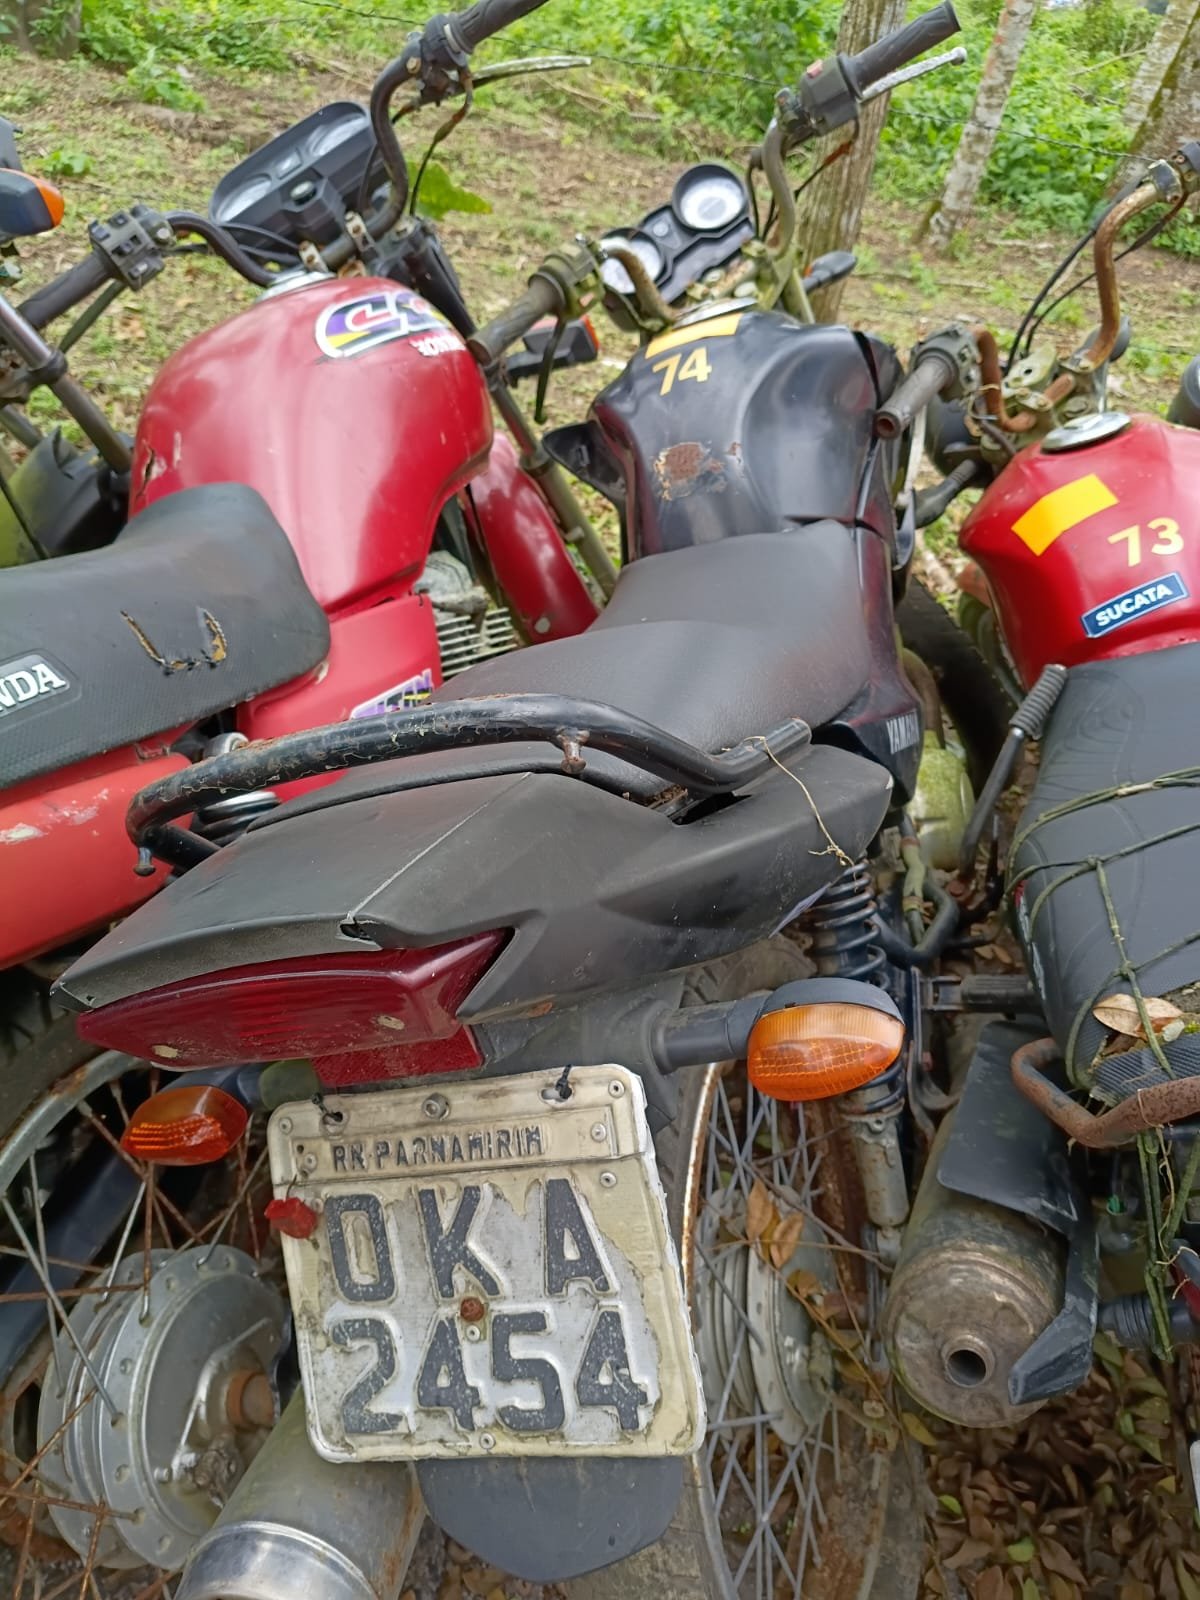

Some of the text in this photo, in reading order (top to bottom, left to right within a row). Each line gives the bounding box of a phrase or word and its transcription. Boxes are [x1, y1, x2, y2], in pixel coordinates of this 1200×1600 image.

[652, 346, 712, 397] 74
[1107, 517, 1184, 568] 73
[1095, 583, 1173, 627] SUCATA
[0, 663, 67, 711] NDA
[331, 1310, 650, 1434] 2454
